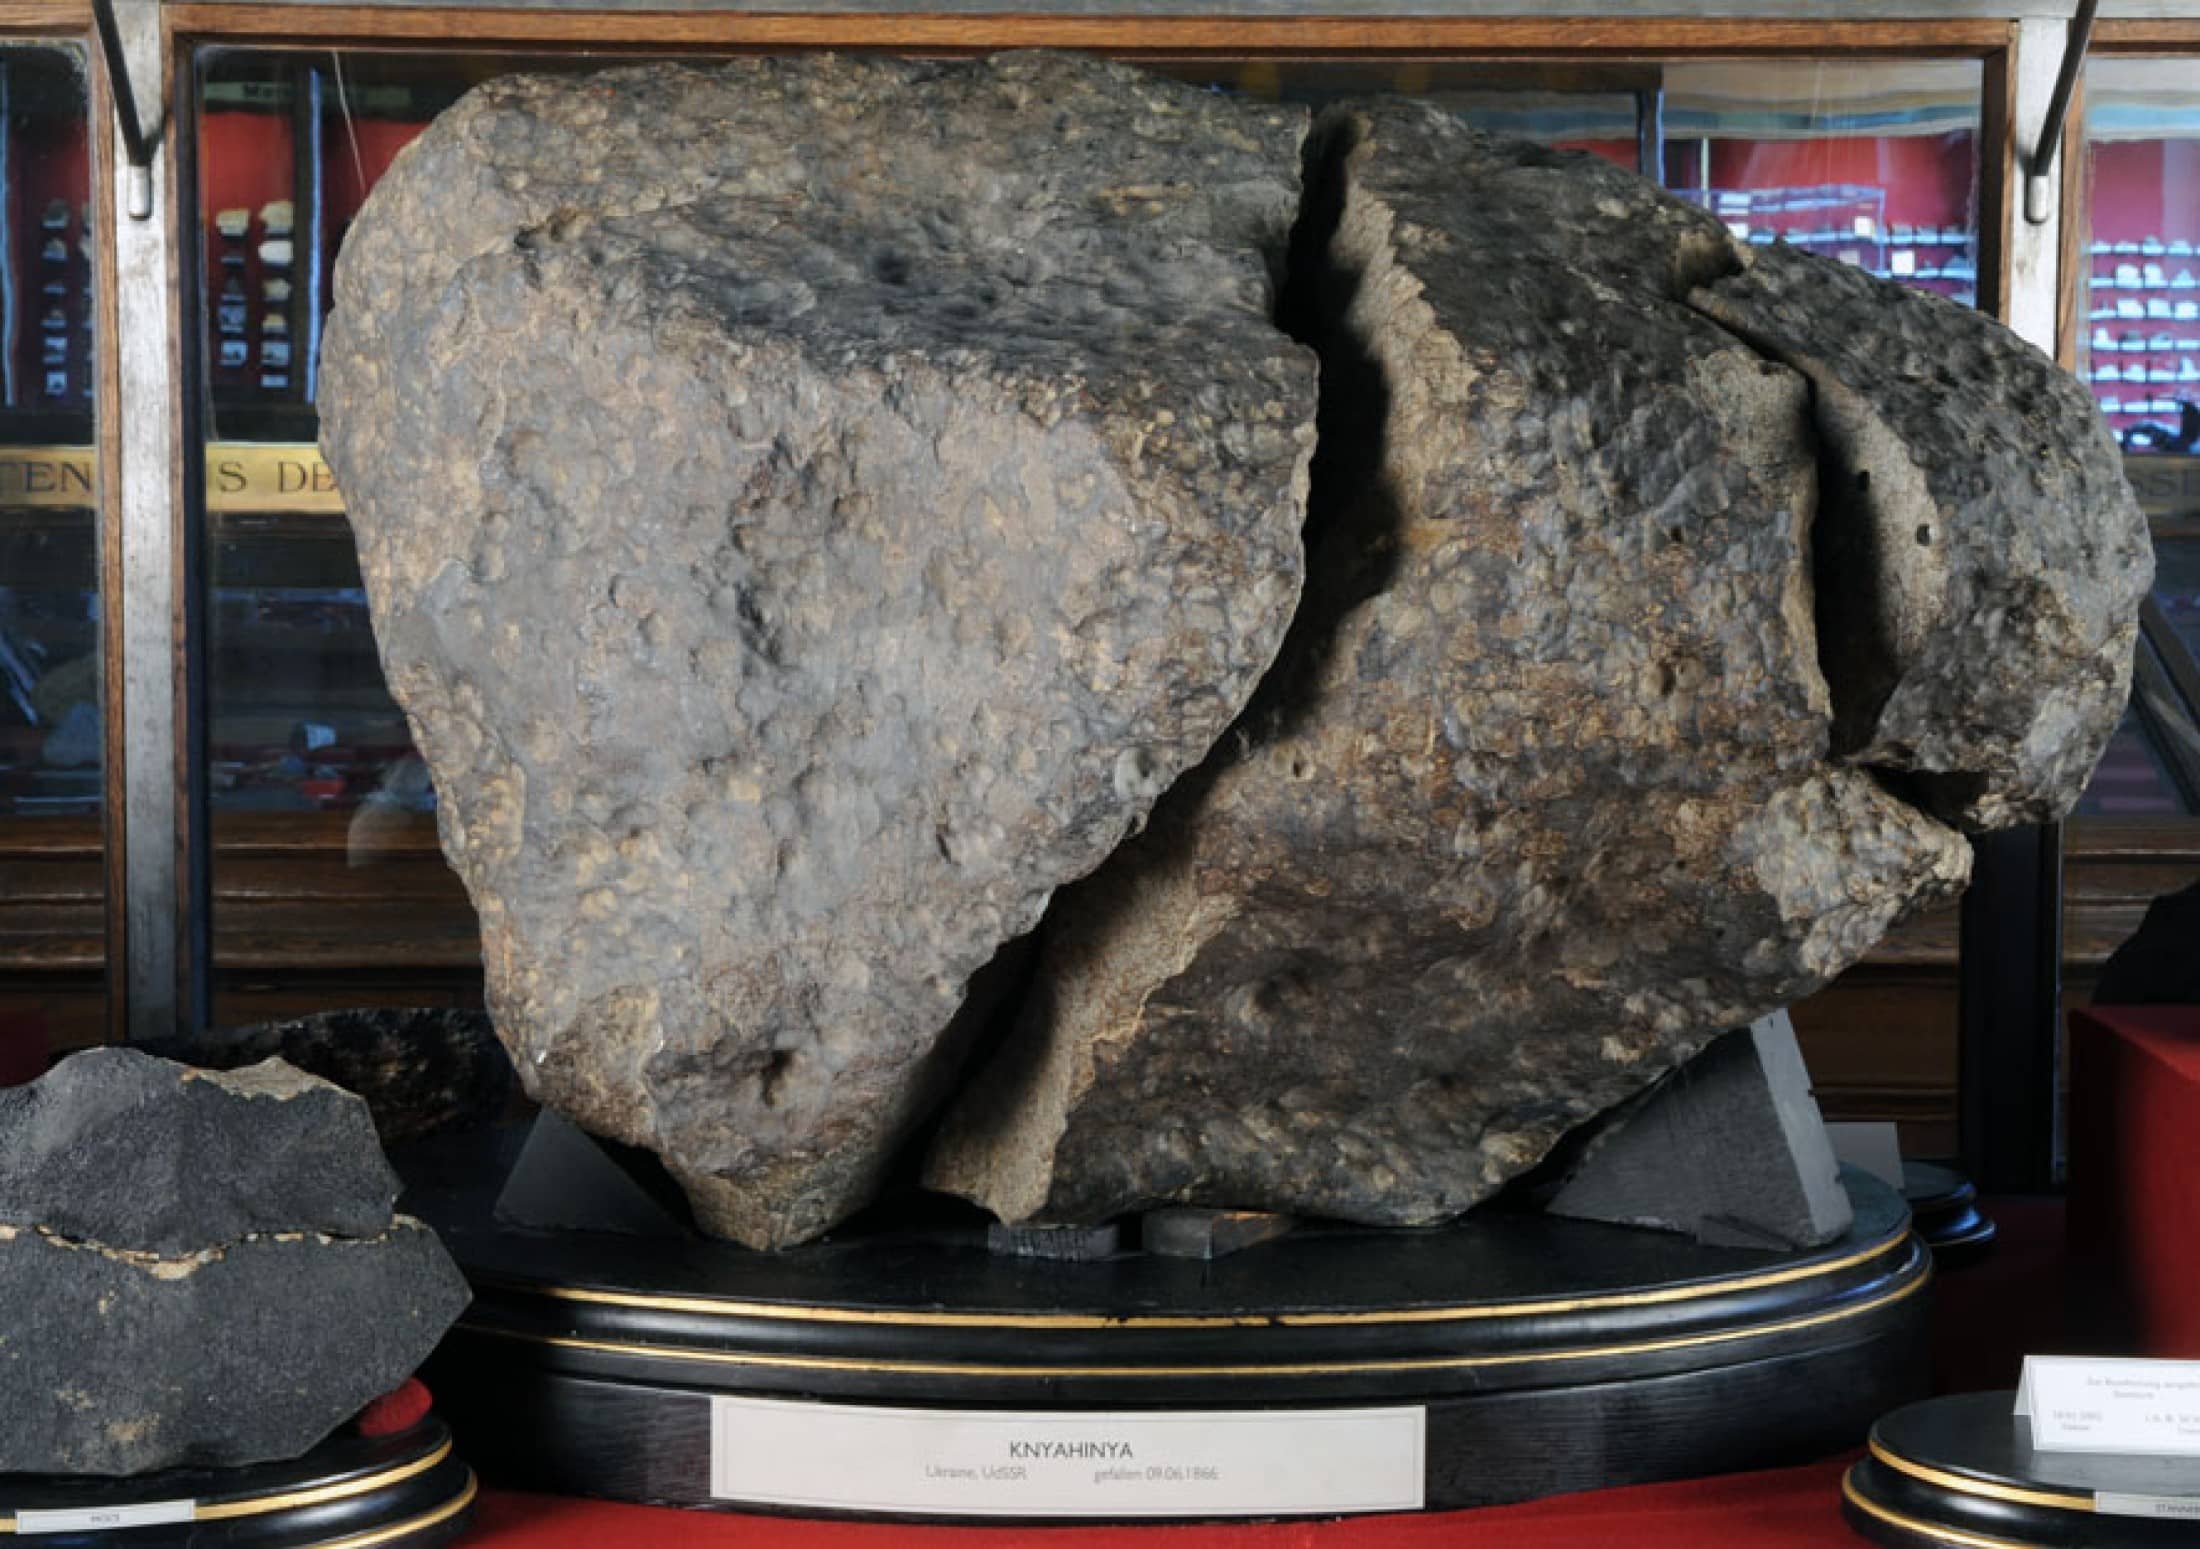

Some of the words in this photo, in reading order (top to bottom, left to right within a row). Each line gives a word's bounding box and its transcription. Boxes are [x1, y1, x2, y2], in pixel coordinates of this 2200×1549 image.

[1009, 1441, 1133, 1458] KNYAHINYA
[925, 1464, 977, 1481] Ukraine,
[981, 1464, 1027, 1481] UdSSR
